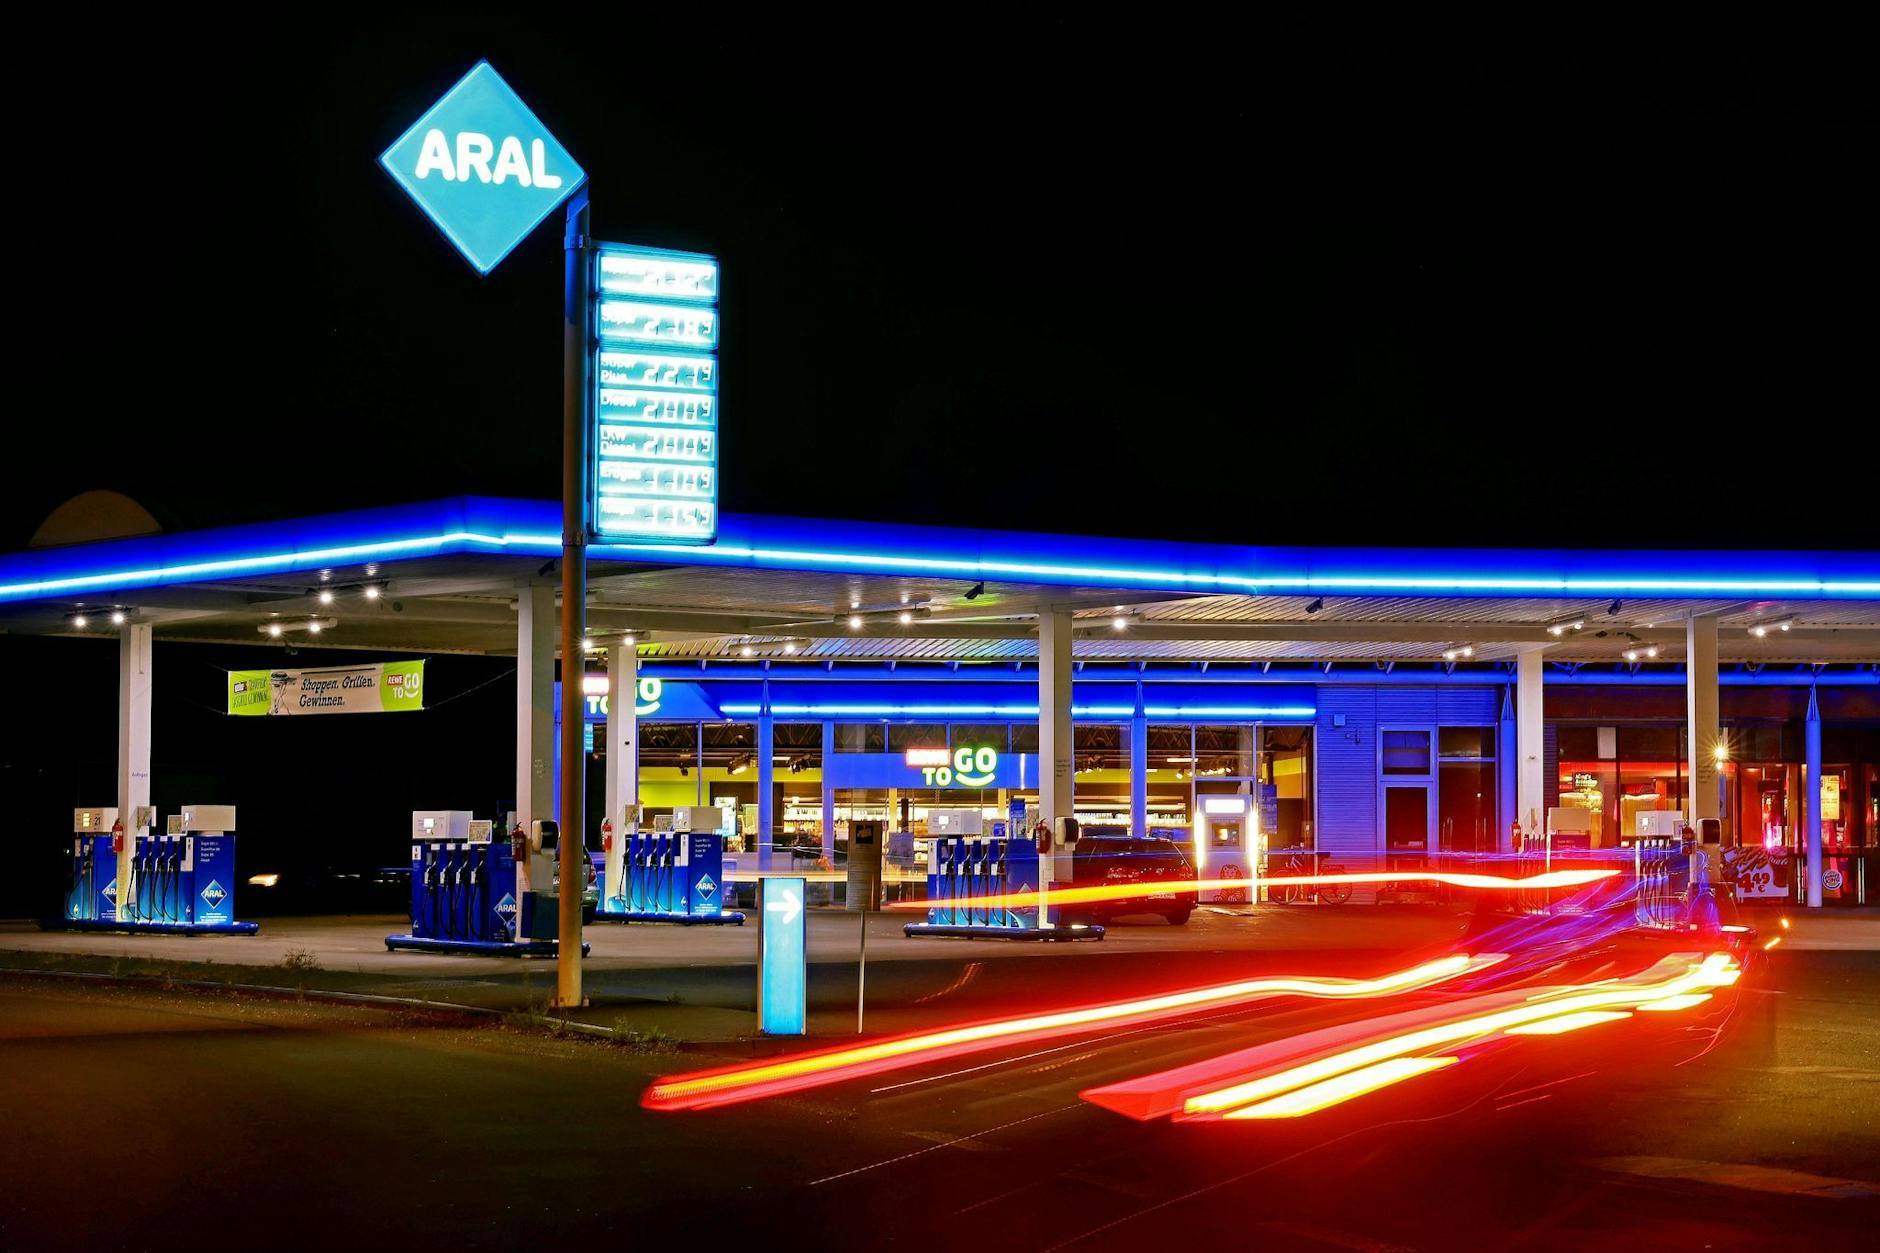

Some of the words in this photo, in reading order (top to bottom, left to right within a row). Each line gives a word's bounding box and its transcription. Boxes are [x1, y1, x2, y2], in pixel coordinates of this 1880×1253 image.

[415, 128, 562, 189] ARAL
[300, 677, 339, 694] Shoppen.
[342, 674, 376, 689] Grillen.
[405, 673, 420, 689] GO
[393, 687, 404, 699] TO
[299, 694, 345, 708] Gewinnen.
[954, 747, 998, 773] GO
[922, 767, 952, 787] TO
[94, 816, 101, 826] 21
[104, 887, 117, 895] AR
[204, 889, 224, 898] ARAL
[698, 883, 715, 891] ARAL
[497, 903, 517, 912] ARAL
